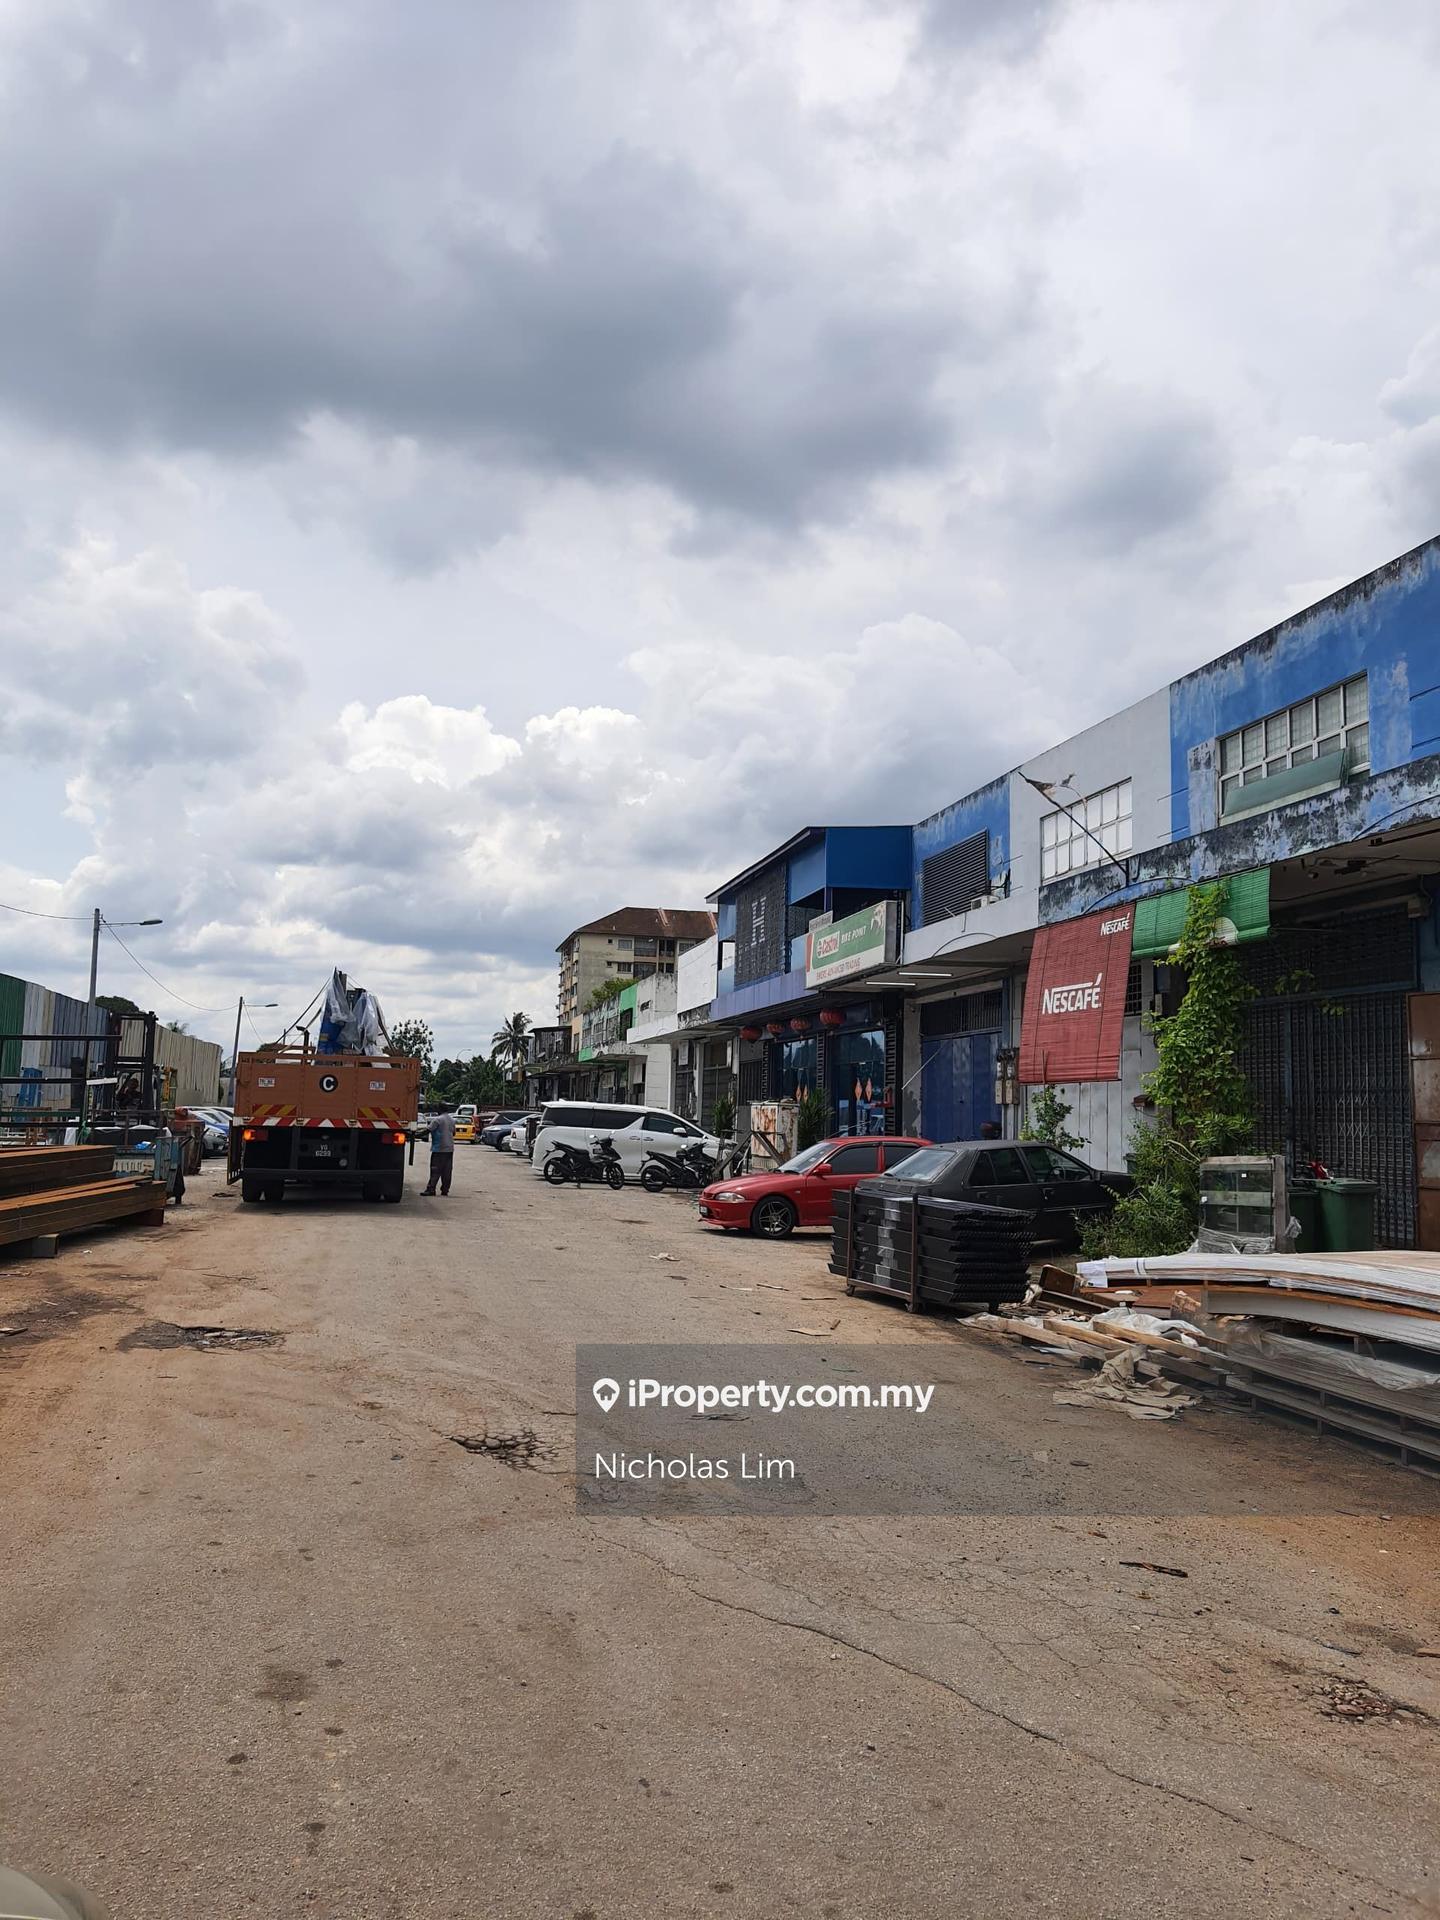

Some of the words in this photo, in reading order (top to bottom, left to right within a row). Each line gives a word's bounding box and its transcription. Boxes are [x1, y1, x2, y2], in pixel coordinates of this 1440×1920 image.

[852, 925, 867, 939] POINT
[1100, 912, 1131, 937] NESCAFÉ
[1042, 973, 1103, 1015] NESCAFÉ
[323, 1077, 335, 1090] C
